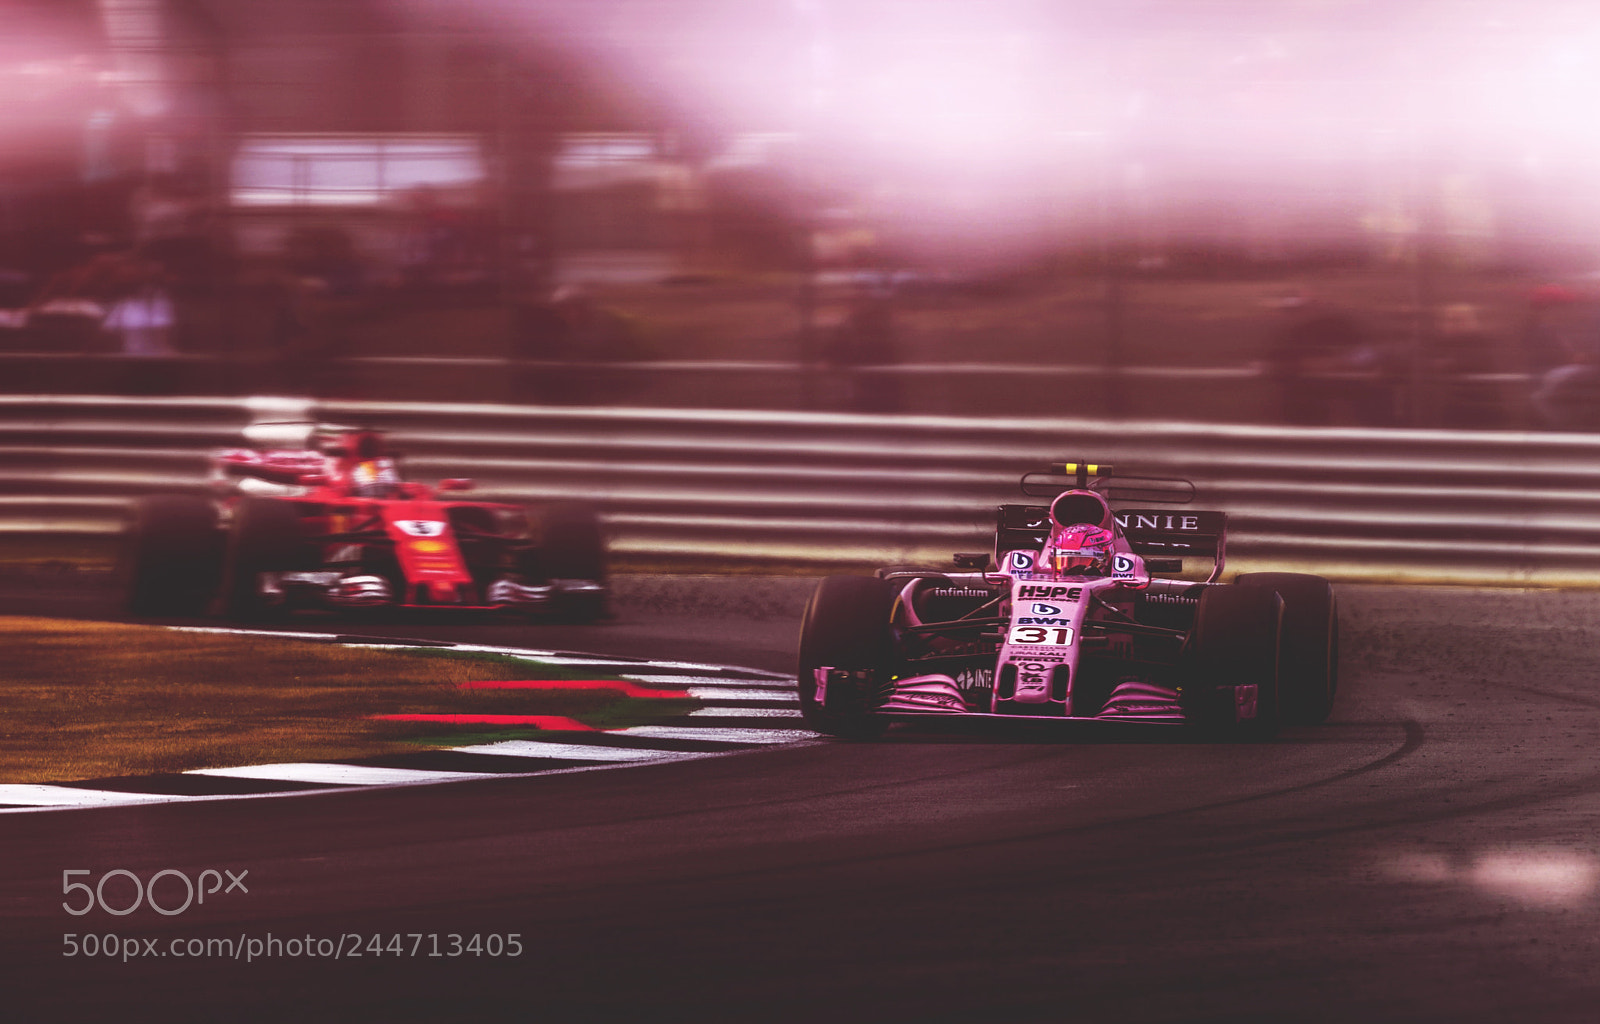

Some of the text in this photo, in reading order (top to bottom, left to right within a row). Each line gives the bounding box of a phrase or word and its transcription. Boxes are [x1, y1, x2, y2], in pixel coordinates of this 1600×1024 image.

[1018, 586, 1082, 599] HYPE
[1018, 617, 1071, 626] BWT
[1015, 627, 1068, 645] 31
